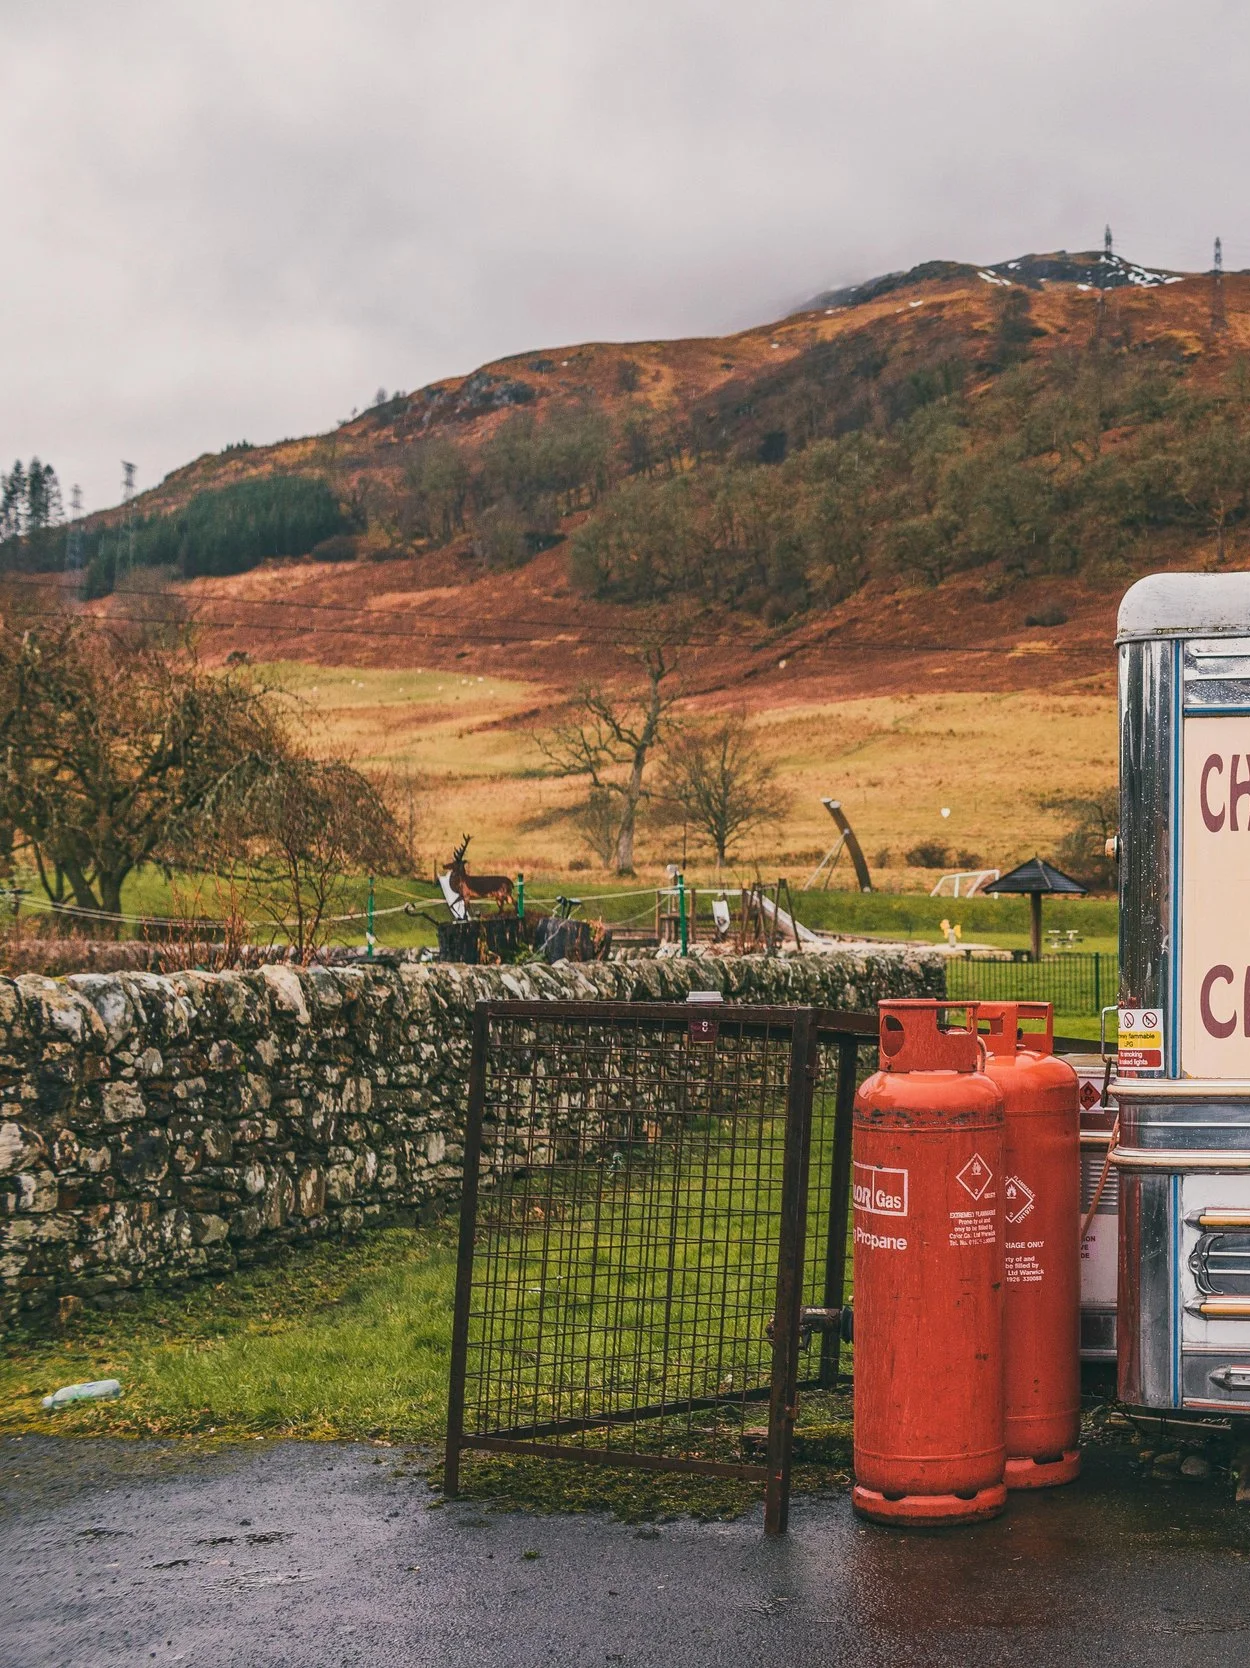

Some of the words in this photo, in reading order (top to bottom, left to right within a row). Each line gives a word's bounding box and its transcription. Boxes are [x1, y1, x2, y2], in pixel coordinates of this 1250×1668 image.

[875, 1189, 902, 1209] Gas
[856, 1226, 908, 1251] Propane
[1026, 1240, 1045, 1249] ONLY
[1031, 1262, 1040, 1270] by
[1019, 1268, 1045, 1276] Warwick
